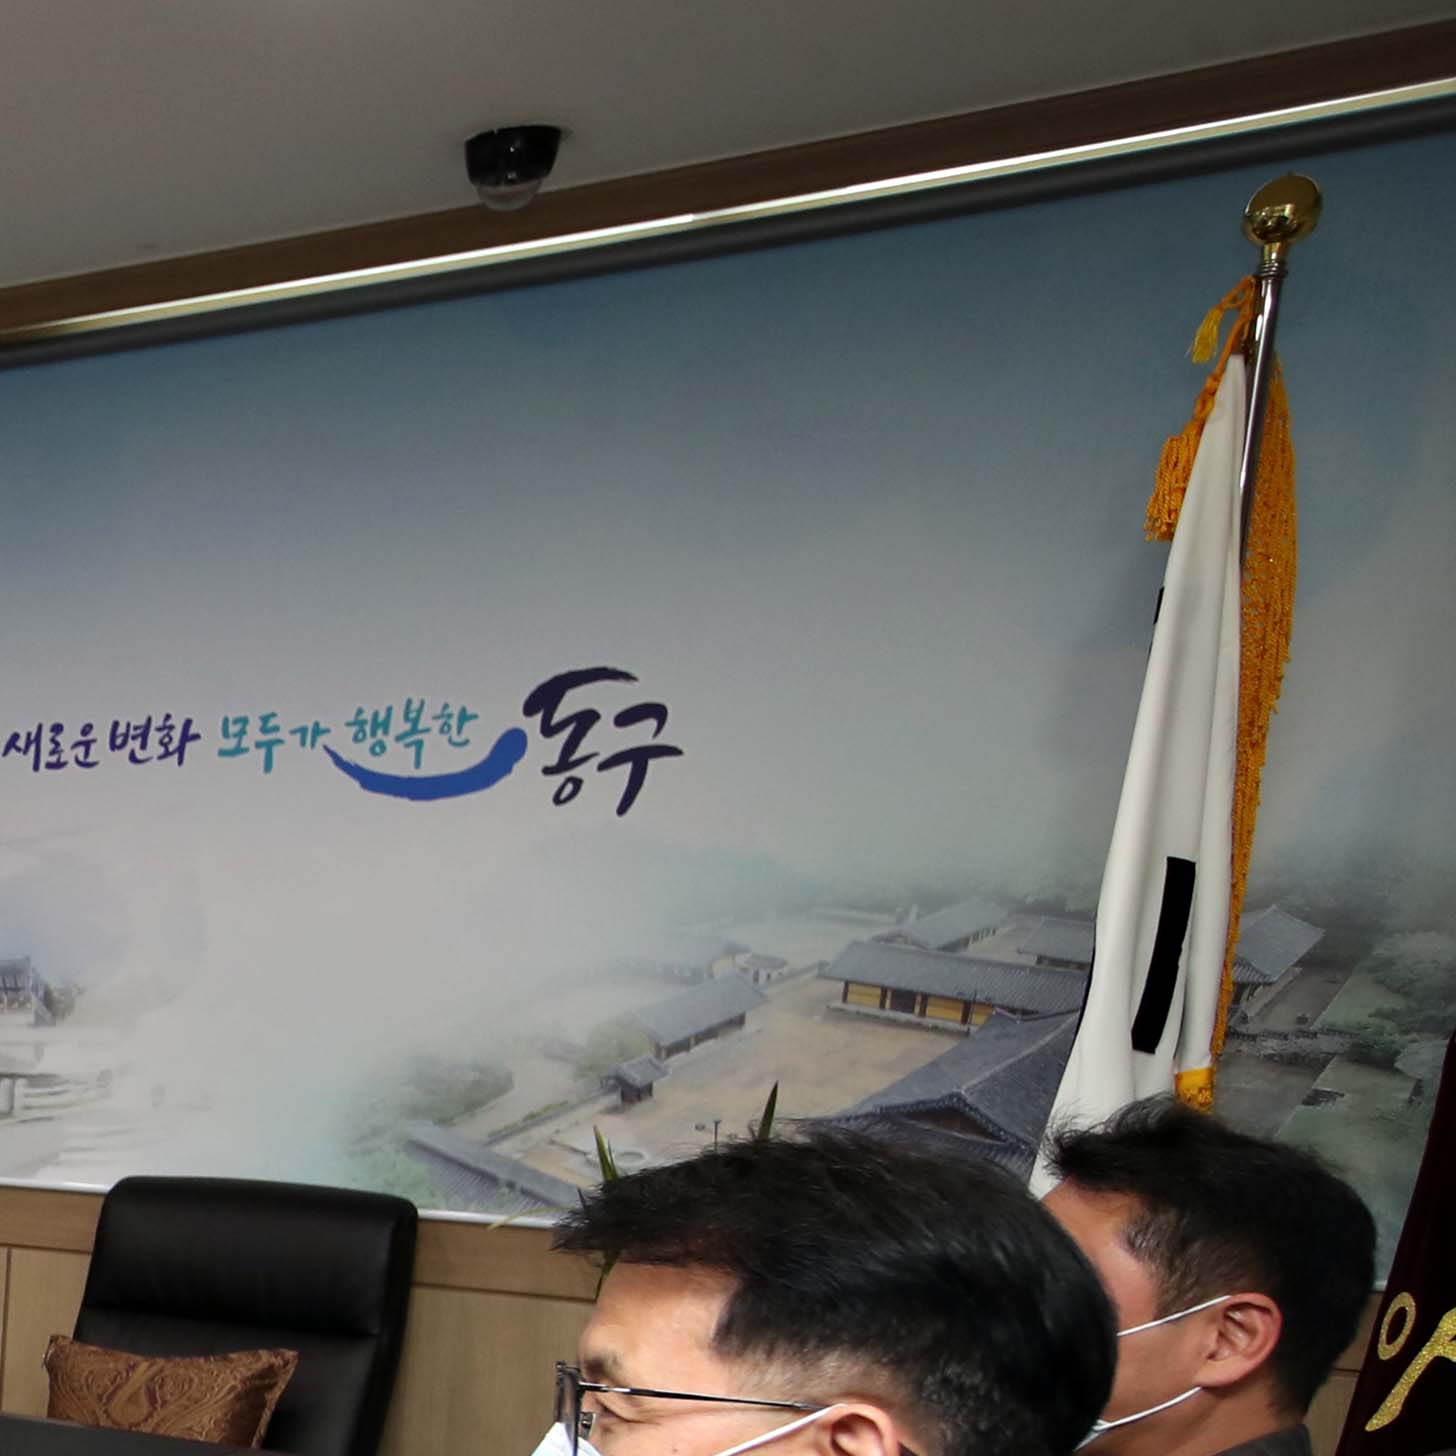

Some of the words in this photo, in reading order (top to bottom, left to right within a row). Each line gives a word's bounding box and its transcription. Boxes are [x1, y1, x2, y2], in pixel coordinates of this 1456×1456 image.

[2, 721, 100, 772] 새로운
[108, 713, 201, 767] 변화
[216, 715, 331, 773] 모두가
[344, 697, 479, 770] 행복한
[523, 666, 685, 816] 동구
